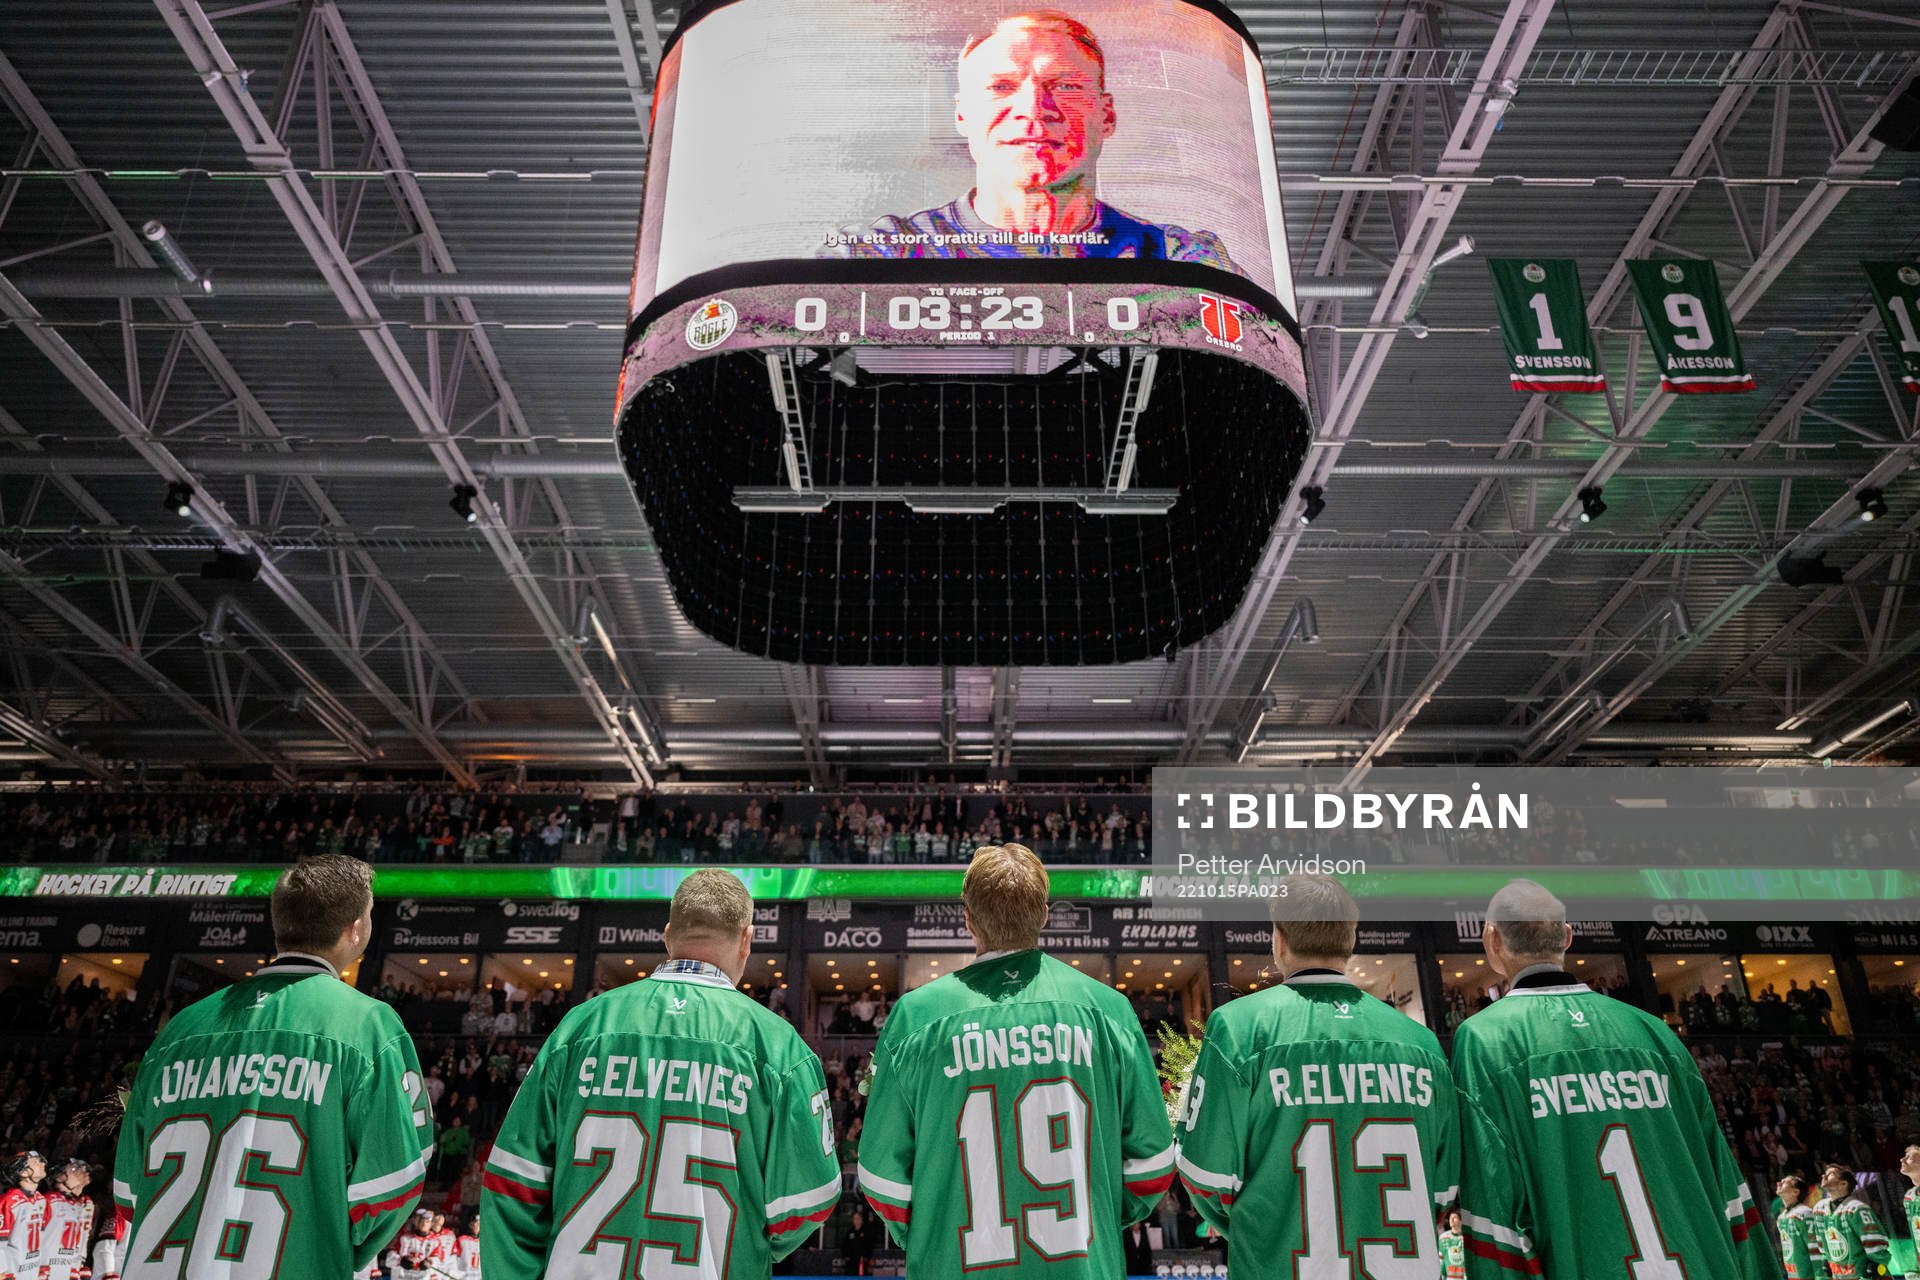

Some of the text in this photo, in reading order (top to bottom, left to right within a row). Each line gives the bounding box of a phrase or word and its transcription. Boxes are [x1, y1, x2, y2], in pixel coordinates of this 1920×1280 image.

[863, 232, 886, 244] ett
[890, 232, 929, 244] stort
[934, 232, 987, 247] grattis
[992, 232, 1013, 244] till
[1018, 232, 1045, 244] din
[1049, 232, 1109, 244] karriär.
[929, 287, 1005, 296] TO FACE-OFF
[794, 297, 827, 331] 0
[888, 297, 1044, 330] 03:23
[1107, 297, 1139, 331] 0
[1529, 293, 1563, 350] 1
[1663, 293, 1715, 351] 9
[1887, 295, 1920, 353] 1
[839, 332, 850, 343] 0
[940, 332, 996, 341] PERIOD 1
[1084, 332, 1095, 343] 0
[1514, 354, 1592, 371] SVENSSON
[1667, 352, 1735, 370] ÅKESSON
[34, 868, 238, 896] HOCKEY PÅ RIKTIGT
[519, 901, 580, 921] swedlog
[1652, 903, 1710, 926] GPA
[463, 932, 480, 946] Bil
[504, 926, 564, 944] SSE
[824, 931, 882, 948] DACO
[943, 1022, 1093, 1079] JÖNSSON
[153, 1053, 333, 1108] OHANSSON
[578, 1055, 753, 1116] S.ELVENES
[1269, 1062, 1433, 1109] R.ELVENES
[955, 1075, 1095, 1274] 19
[120, 1110, 308, 1280] 26
[541, 1109, 742, 1280] 25
[1292, 1117, 1442, 1280] 13
[1595, 1122, 1689, 1280] 1
